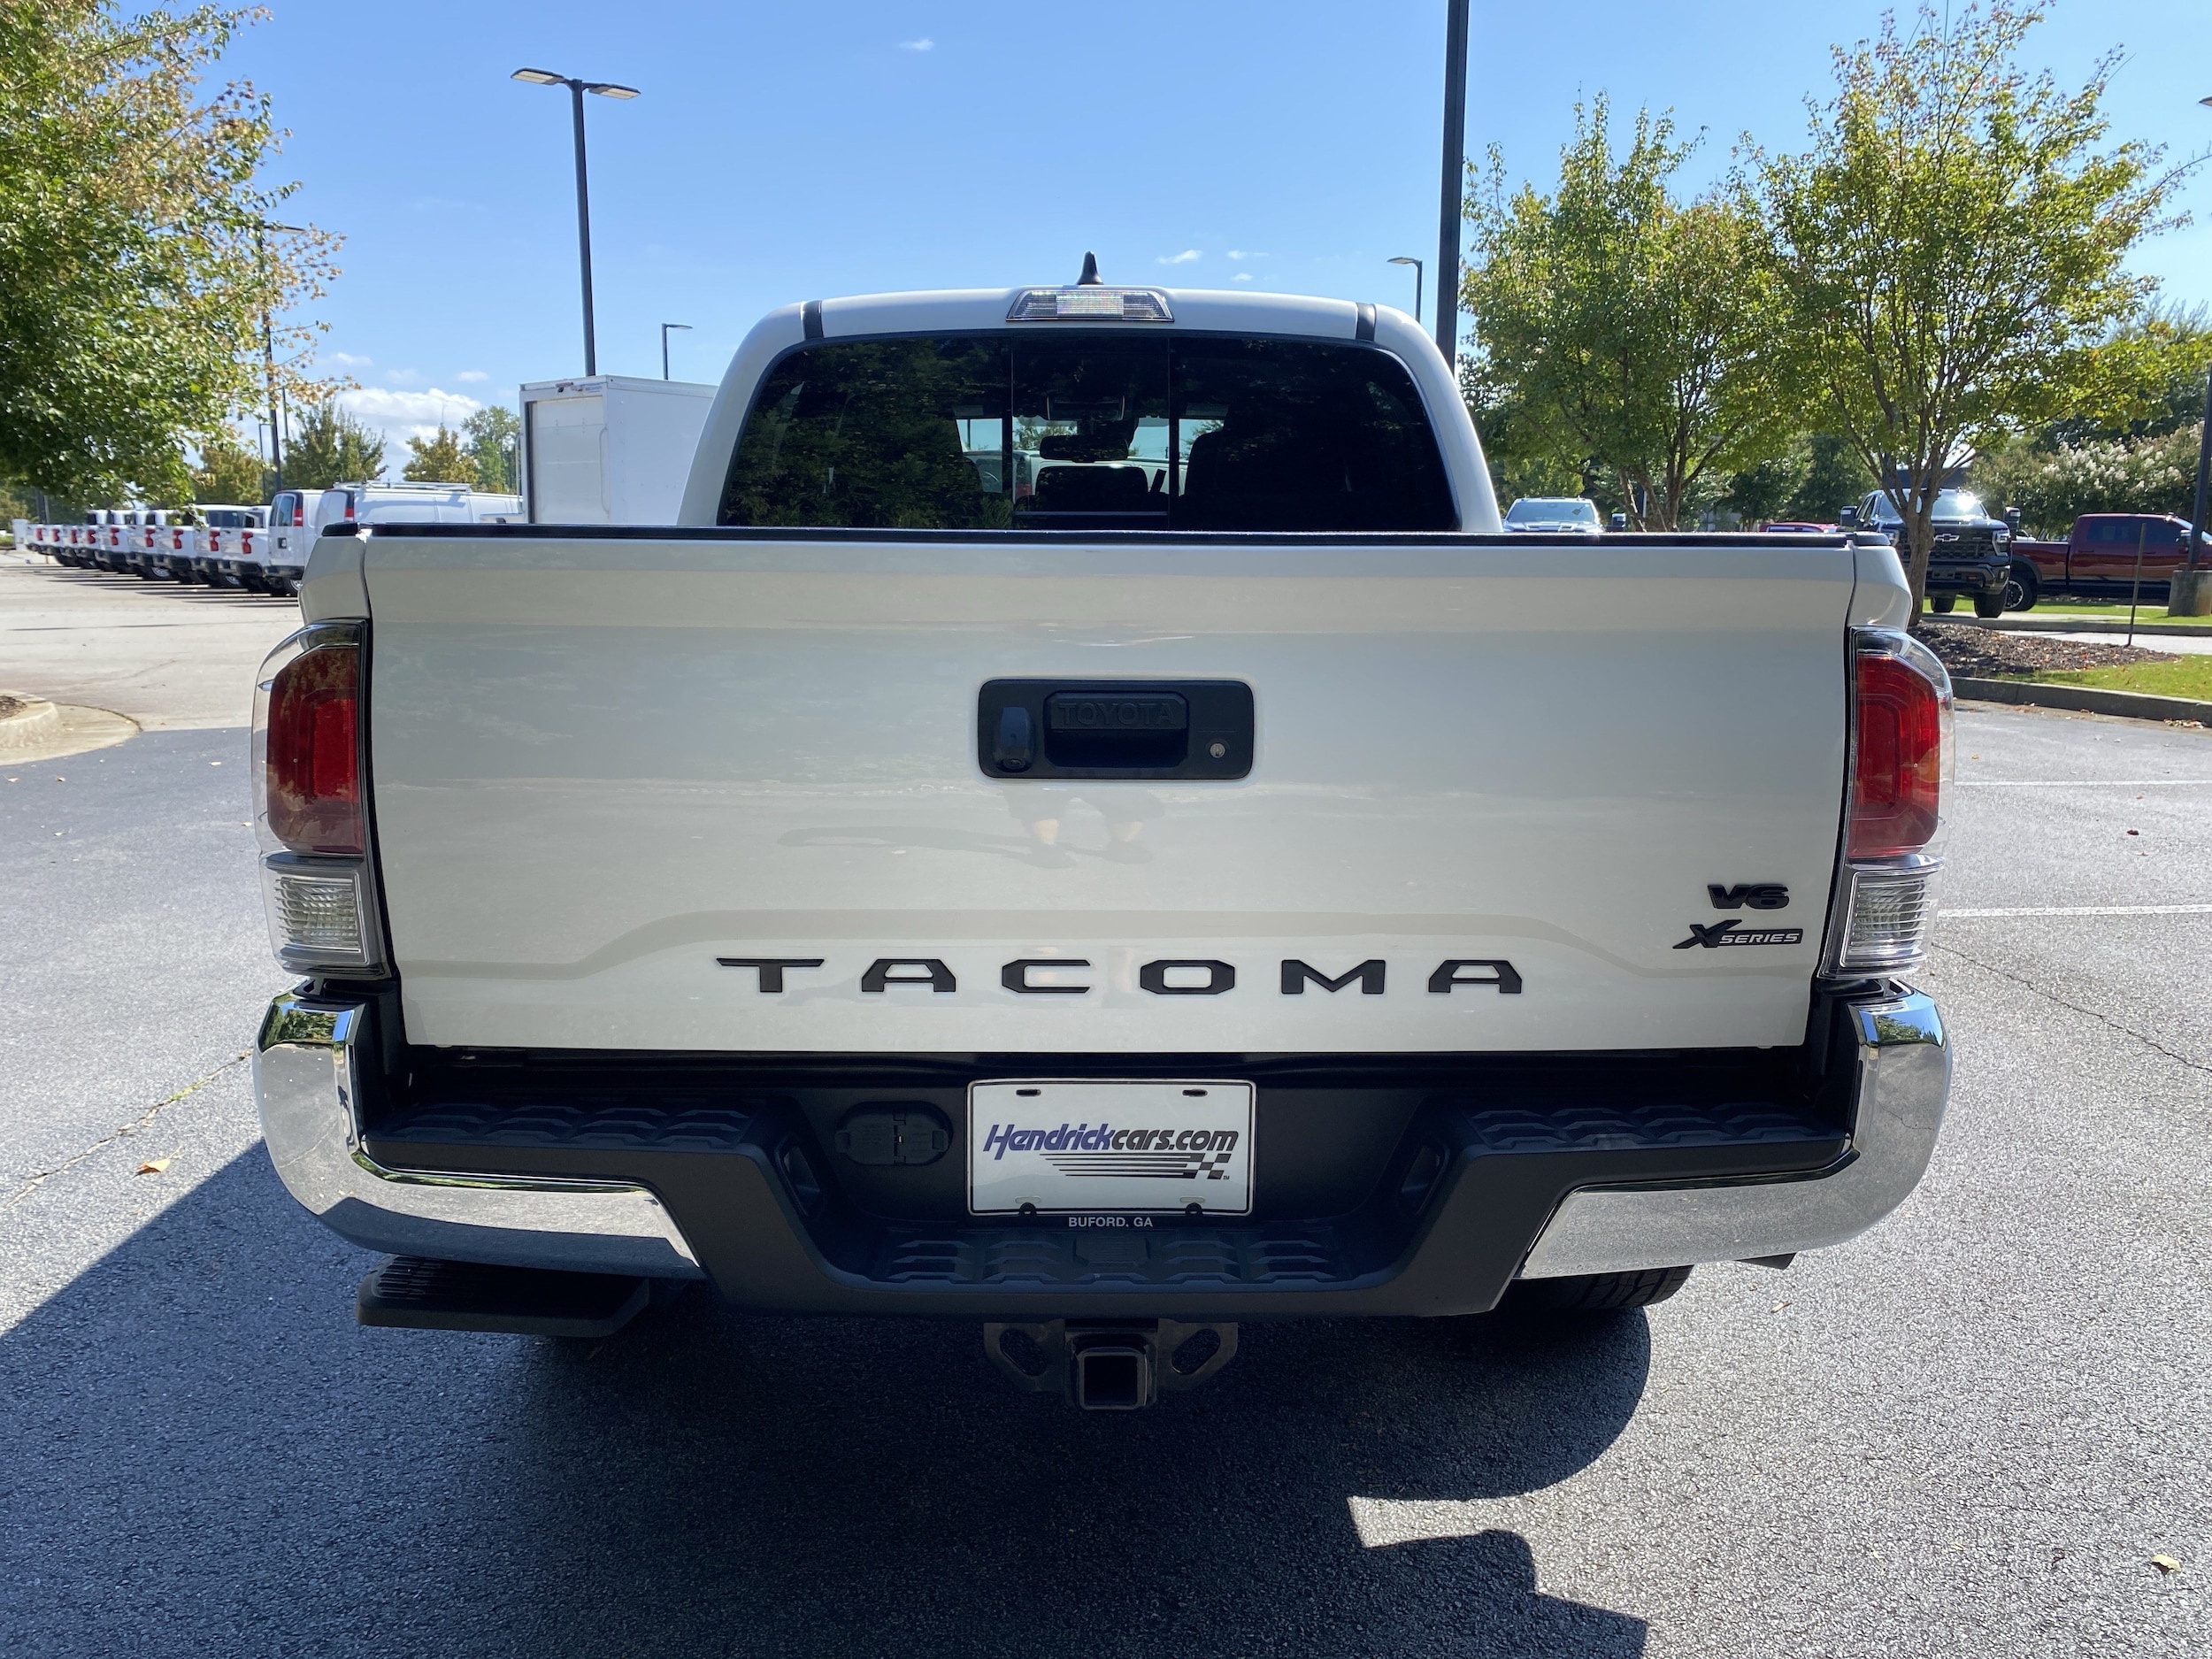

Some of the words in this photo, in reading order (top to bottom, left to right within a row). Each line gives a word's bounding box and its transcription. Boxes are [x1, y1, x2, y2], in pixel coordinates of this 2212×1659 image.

[1058, 703, 1176, 726] TOYOTA
[1707, 883, 1790, 910] V6
[1718, 933, 1800, 944] SERIES
[716, 957, 1523, 994] TACOMA
[982, 1123, 1239, 1161] Hendrickcars.com
[1133, 1216, 1154, 1227] GA
